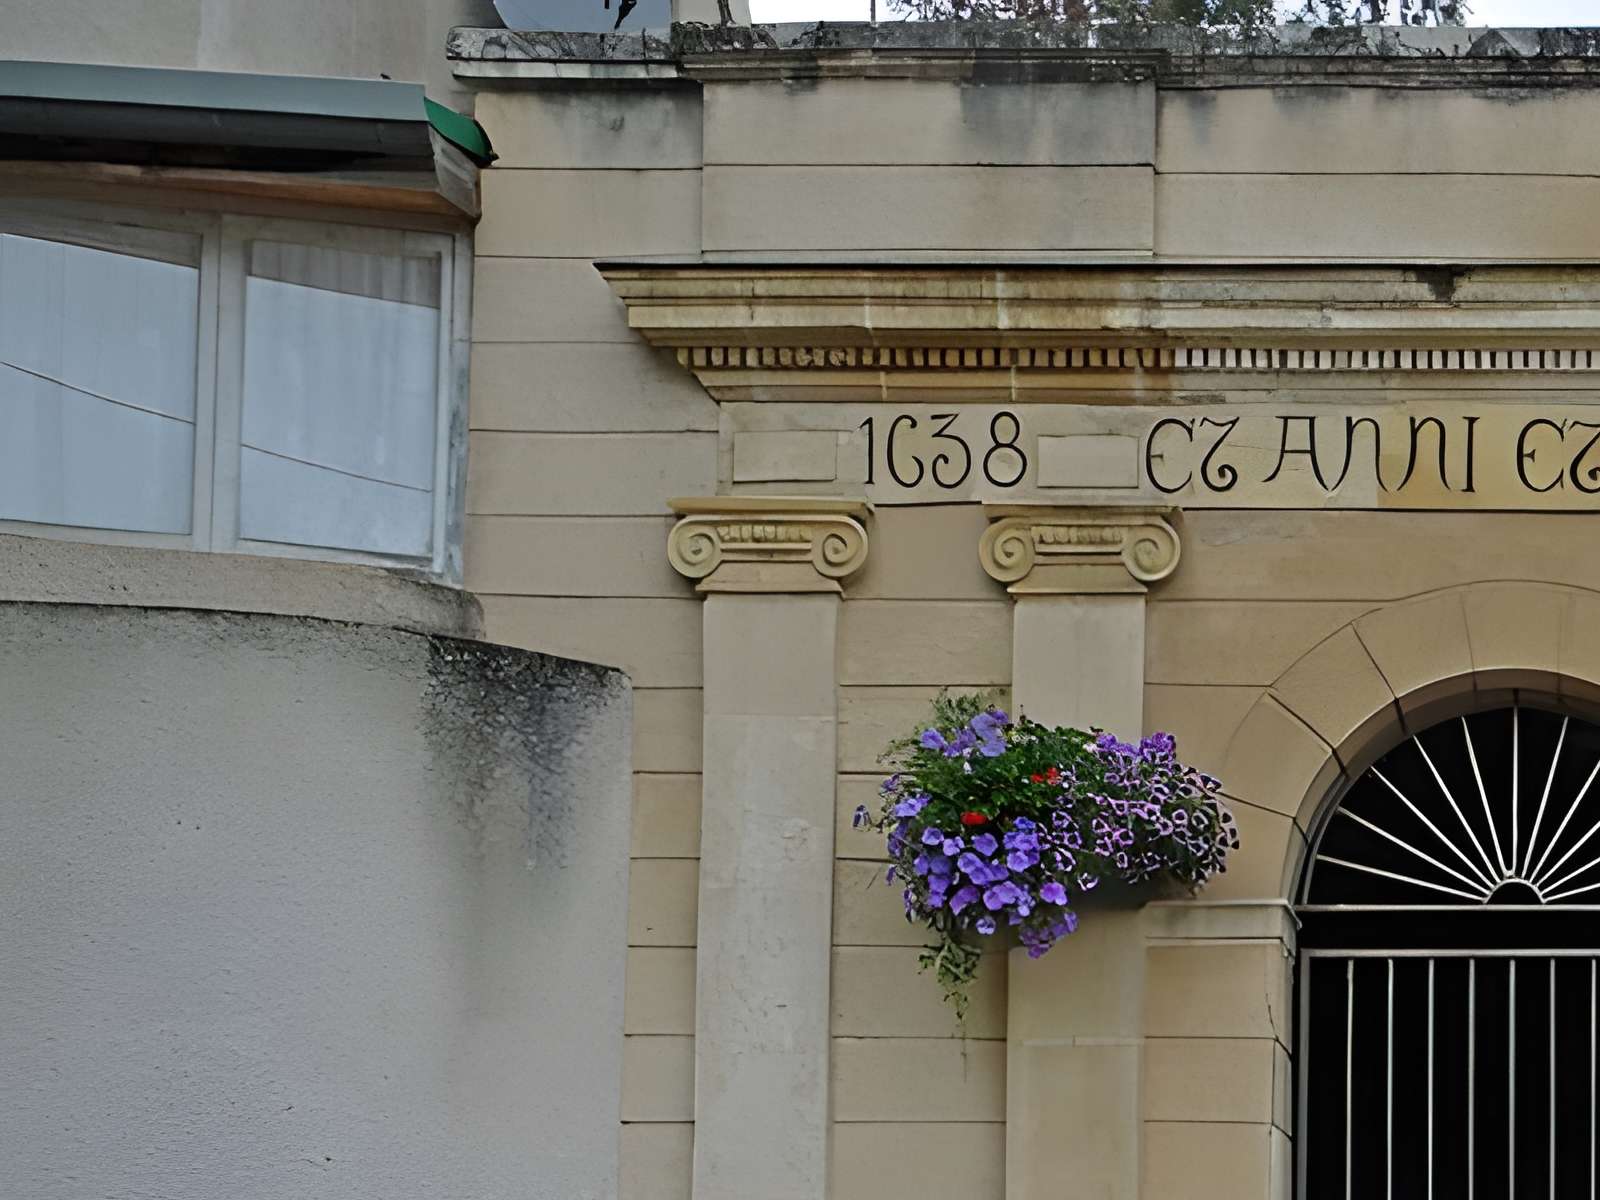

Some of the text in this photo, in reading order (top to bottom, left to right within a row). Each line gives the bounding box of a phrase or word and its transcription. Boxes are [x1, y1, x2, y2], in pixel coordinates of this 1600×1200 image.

[857, 412, 1028, 491] 1638
[1144, 417, 1240, 495] ET
[1262, 415, 1481, 494] ANNI
